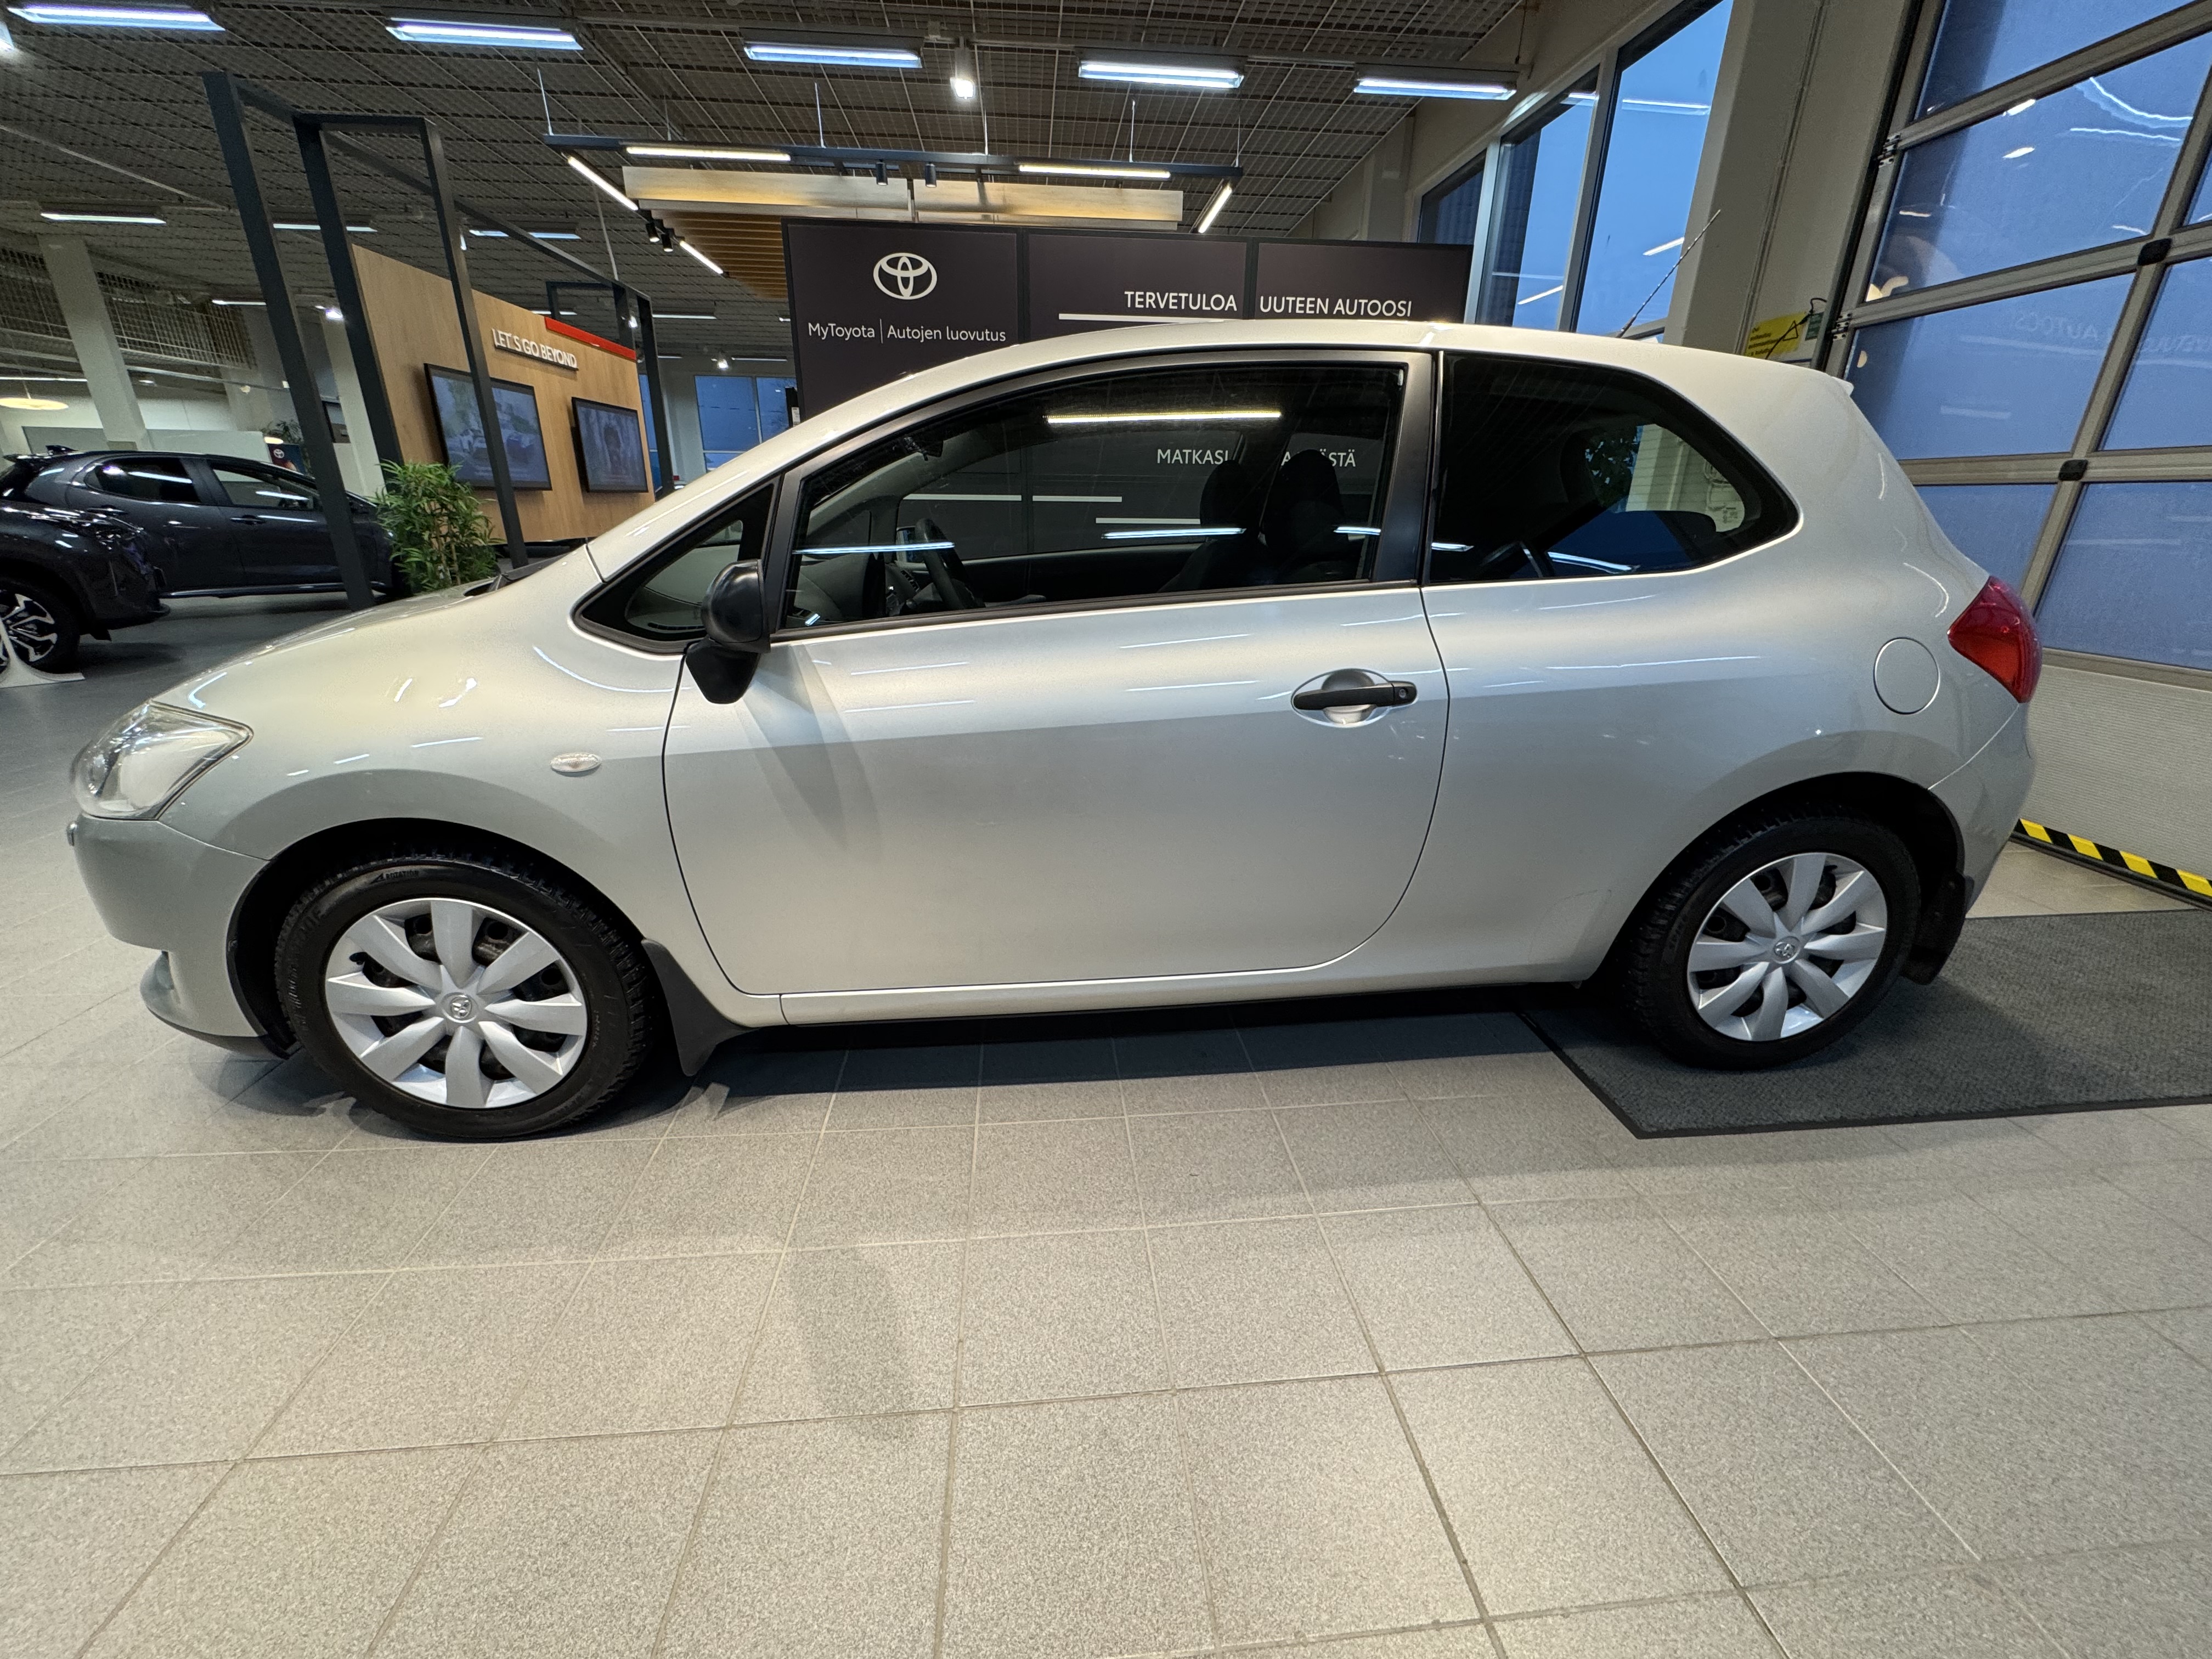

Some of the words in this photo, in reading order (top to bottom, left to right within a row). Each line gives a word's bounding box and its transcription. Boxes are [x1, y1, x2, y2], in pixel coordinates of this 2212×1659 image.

[1124, 291, 1238, 312] TERVETULOA
[1260, 295, 1329, 314] UUTEEN
[1333, 298, 1412, 317] AUTOOSI
[808, 323, 876, 341] MyToyota
[887, 325, 943, 343] Autojen
[946, 326, 1007, 342] luovutus
[522, 338, 539, 357] GO
[539, 343, 578, 368] BEYOND
[1156, 449, 1228, 465] MATKASI
[1297, 448, 1356, 467] STÄ
